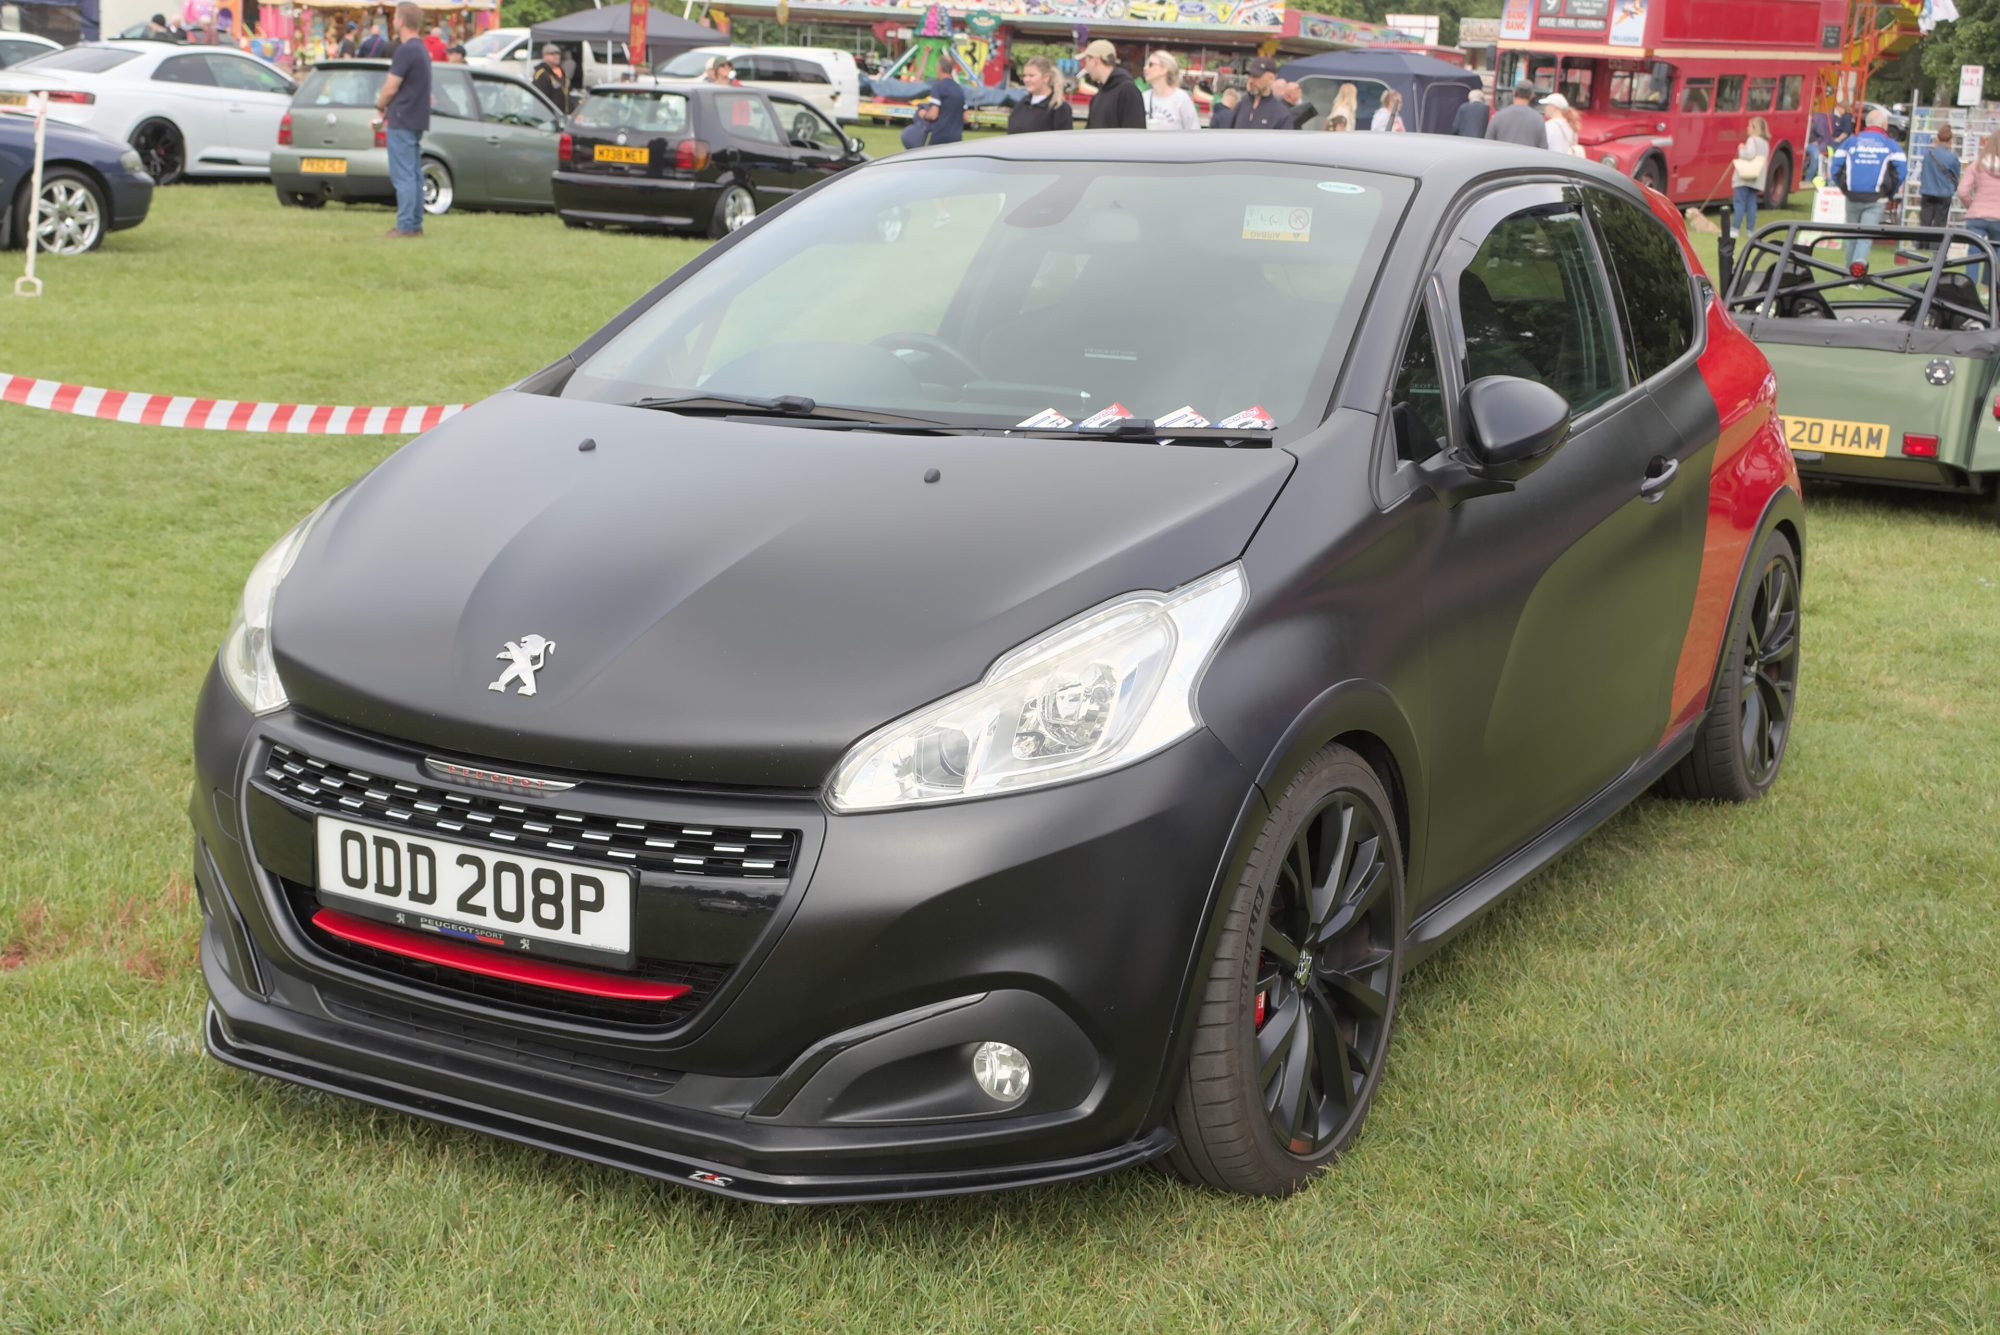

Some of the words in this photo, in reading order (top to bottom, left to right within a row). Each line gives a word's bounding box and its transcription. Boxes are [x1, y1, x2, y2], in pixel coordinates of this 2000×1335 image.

[1829, 423, 1884, 450] HAM
[447, 764, 545, 789] PEUGEOT
[340, 828, 437, 906] ODD
[455, 852, 605, 935] 208P
